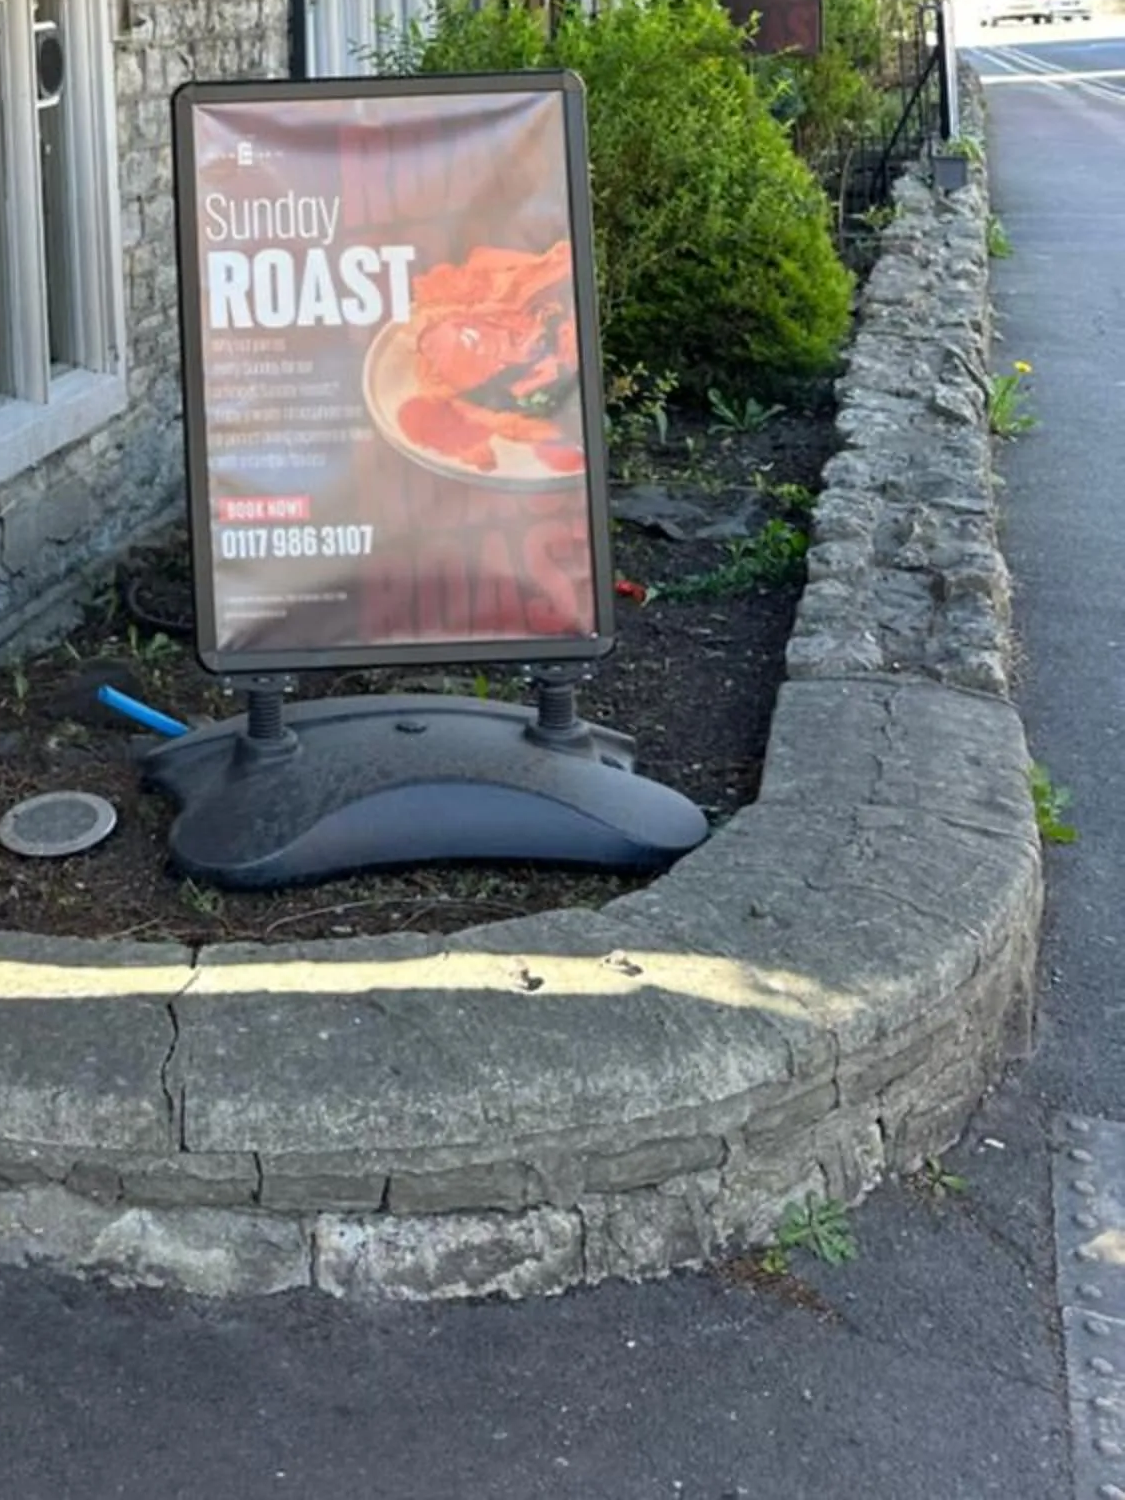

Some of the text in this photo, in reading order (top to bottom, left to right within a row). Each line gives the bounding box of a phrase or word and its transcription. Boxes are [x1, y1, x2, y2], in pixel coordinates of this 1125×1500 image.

[204, 192, 341, 244] Sunday
[206, 244, 416, 331] ROAST
[226, 500, 264, 520] BOOK
[221, 523, 375, 560] 0117 986 3107
